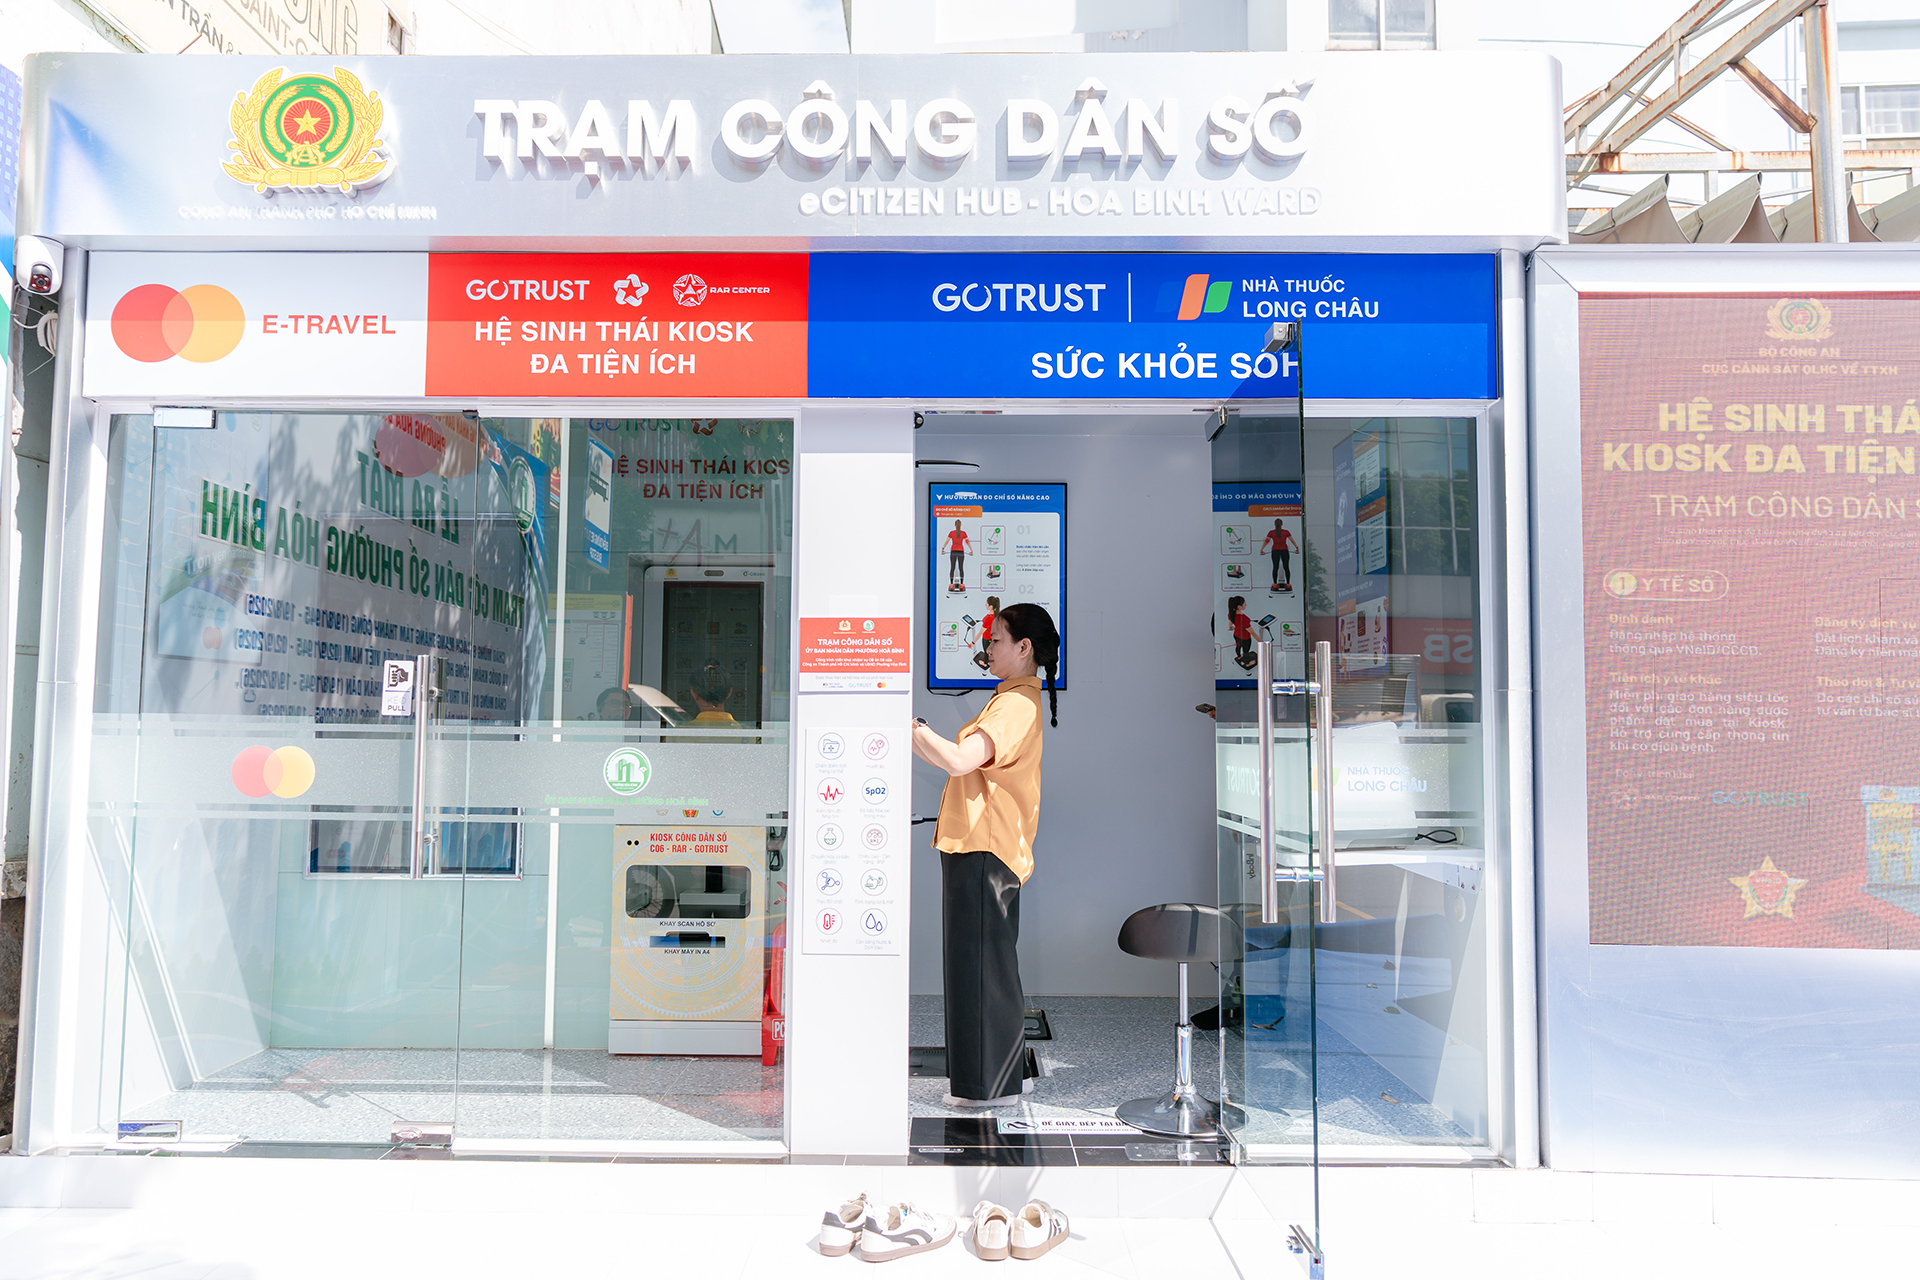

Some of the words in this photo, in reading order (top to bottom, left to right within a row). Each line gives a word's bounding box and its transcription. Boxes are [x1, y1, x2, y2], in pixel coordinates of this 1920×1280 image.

[474, 99, 692, 177] TRẠM
[721, 79, 977, 160] CÔNG
[1007, 77, 1178, 161] DÂN
[1207, 77, 1317, 160] SỐ
[798, 187, 945, 216] eCITIZEN
[955, 187, 1022, 216] HUB
[1048, 187, 1122, 216] HOA
[1132, 187, 1211, 216] BINH
[1223, 187, 1323, 216] WARD
[466, 279, 590, 301] GOTRUST
[709, 286, 731, 294] RAR
[732, 286, 770, 294] CENTER
[1242, 275, 1280, 293] NHÀ
[1284, 274, 1345, 293] THUỐC
[932, 282, 1106, 312] GOTRUST
[1243, 300, 1306, 318] LONG
[1314, 297, 1379, 318] CHÂU
[262, 314, 396, 335] E-TRAVEL
[475, 316, 512, 345] HỆ
[521, 321, 586, 342] SINH
[595, 316, 658, 342] THÁI
[668, 321, 753, 342] KIOSK
[1031, 345, 1105, 379] SỨC
[1118, 343, 1217, 378] KHỎE
[1780, 346, 1816, 358] CÔNG
[1820, 348, 1840, 357] AN
[530, 353, 569, 374] ĐA
[577, 349, 639, 378] TIỆN
[650, 349, 696, 374] ÍCH
[1861, 365, 1898, 375] TTXH
[1659, 397, 1713, 442] HỆ
[1724, 403, 1825, 432] SINH
[636, 459, 683, 474] SINH
[690, 456, 736, 474] THÁI
[1603, 444, 1733, 472] KIOSK
[1744, 445, 1806, 474] ĐA
[1817, 438, 1915, 483] TIỆN
[643, 484, 670, 498] ĐA
[677, 480, 722, 501] TIỆN
[730, 480, 763, 499] ÍCH
[1650, 494, 1736, 522] TRẠM
[1747, 491, 1833, 518] CÔNG
[1843, 492, 1906, 519] DÂN
[1017, 525, 1031, 535] 01
[1018, 584, 1034, 594] 02
[1642, 579, 1654, 592] Y
[1659, 574, 1684, 592] TẾ
[1688, 573, 1714, 593] SỐ
[841, 637, 863, 646] CÔNG
[881, 637, 893, 646] SỐ
[1347, 764, 1369, 775] NHÀ
[1372, 763, 1409, 775] THUỐC
[865, 787, 886, 796] SpO2
[1347, 780, 1386, 792] LONG
[1389, 777, 1427, 792] CHÂU
[1712, 790, 1810, 807] GOTRUST
[650, 833, 674, 842] KIOSK
[675, 832, 697, 842] CÔNG
[698, 832, 715, 842] DÂN
[716, 831, 728, 842] SỐ
[650, 845, 665, 853] C06
[672, 845, 687, 853] RAR
[694, 845, 728, 854] GOTRUST
